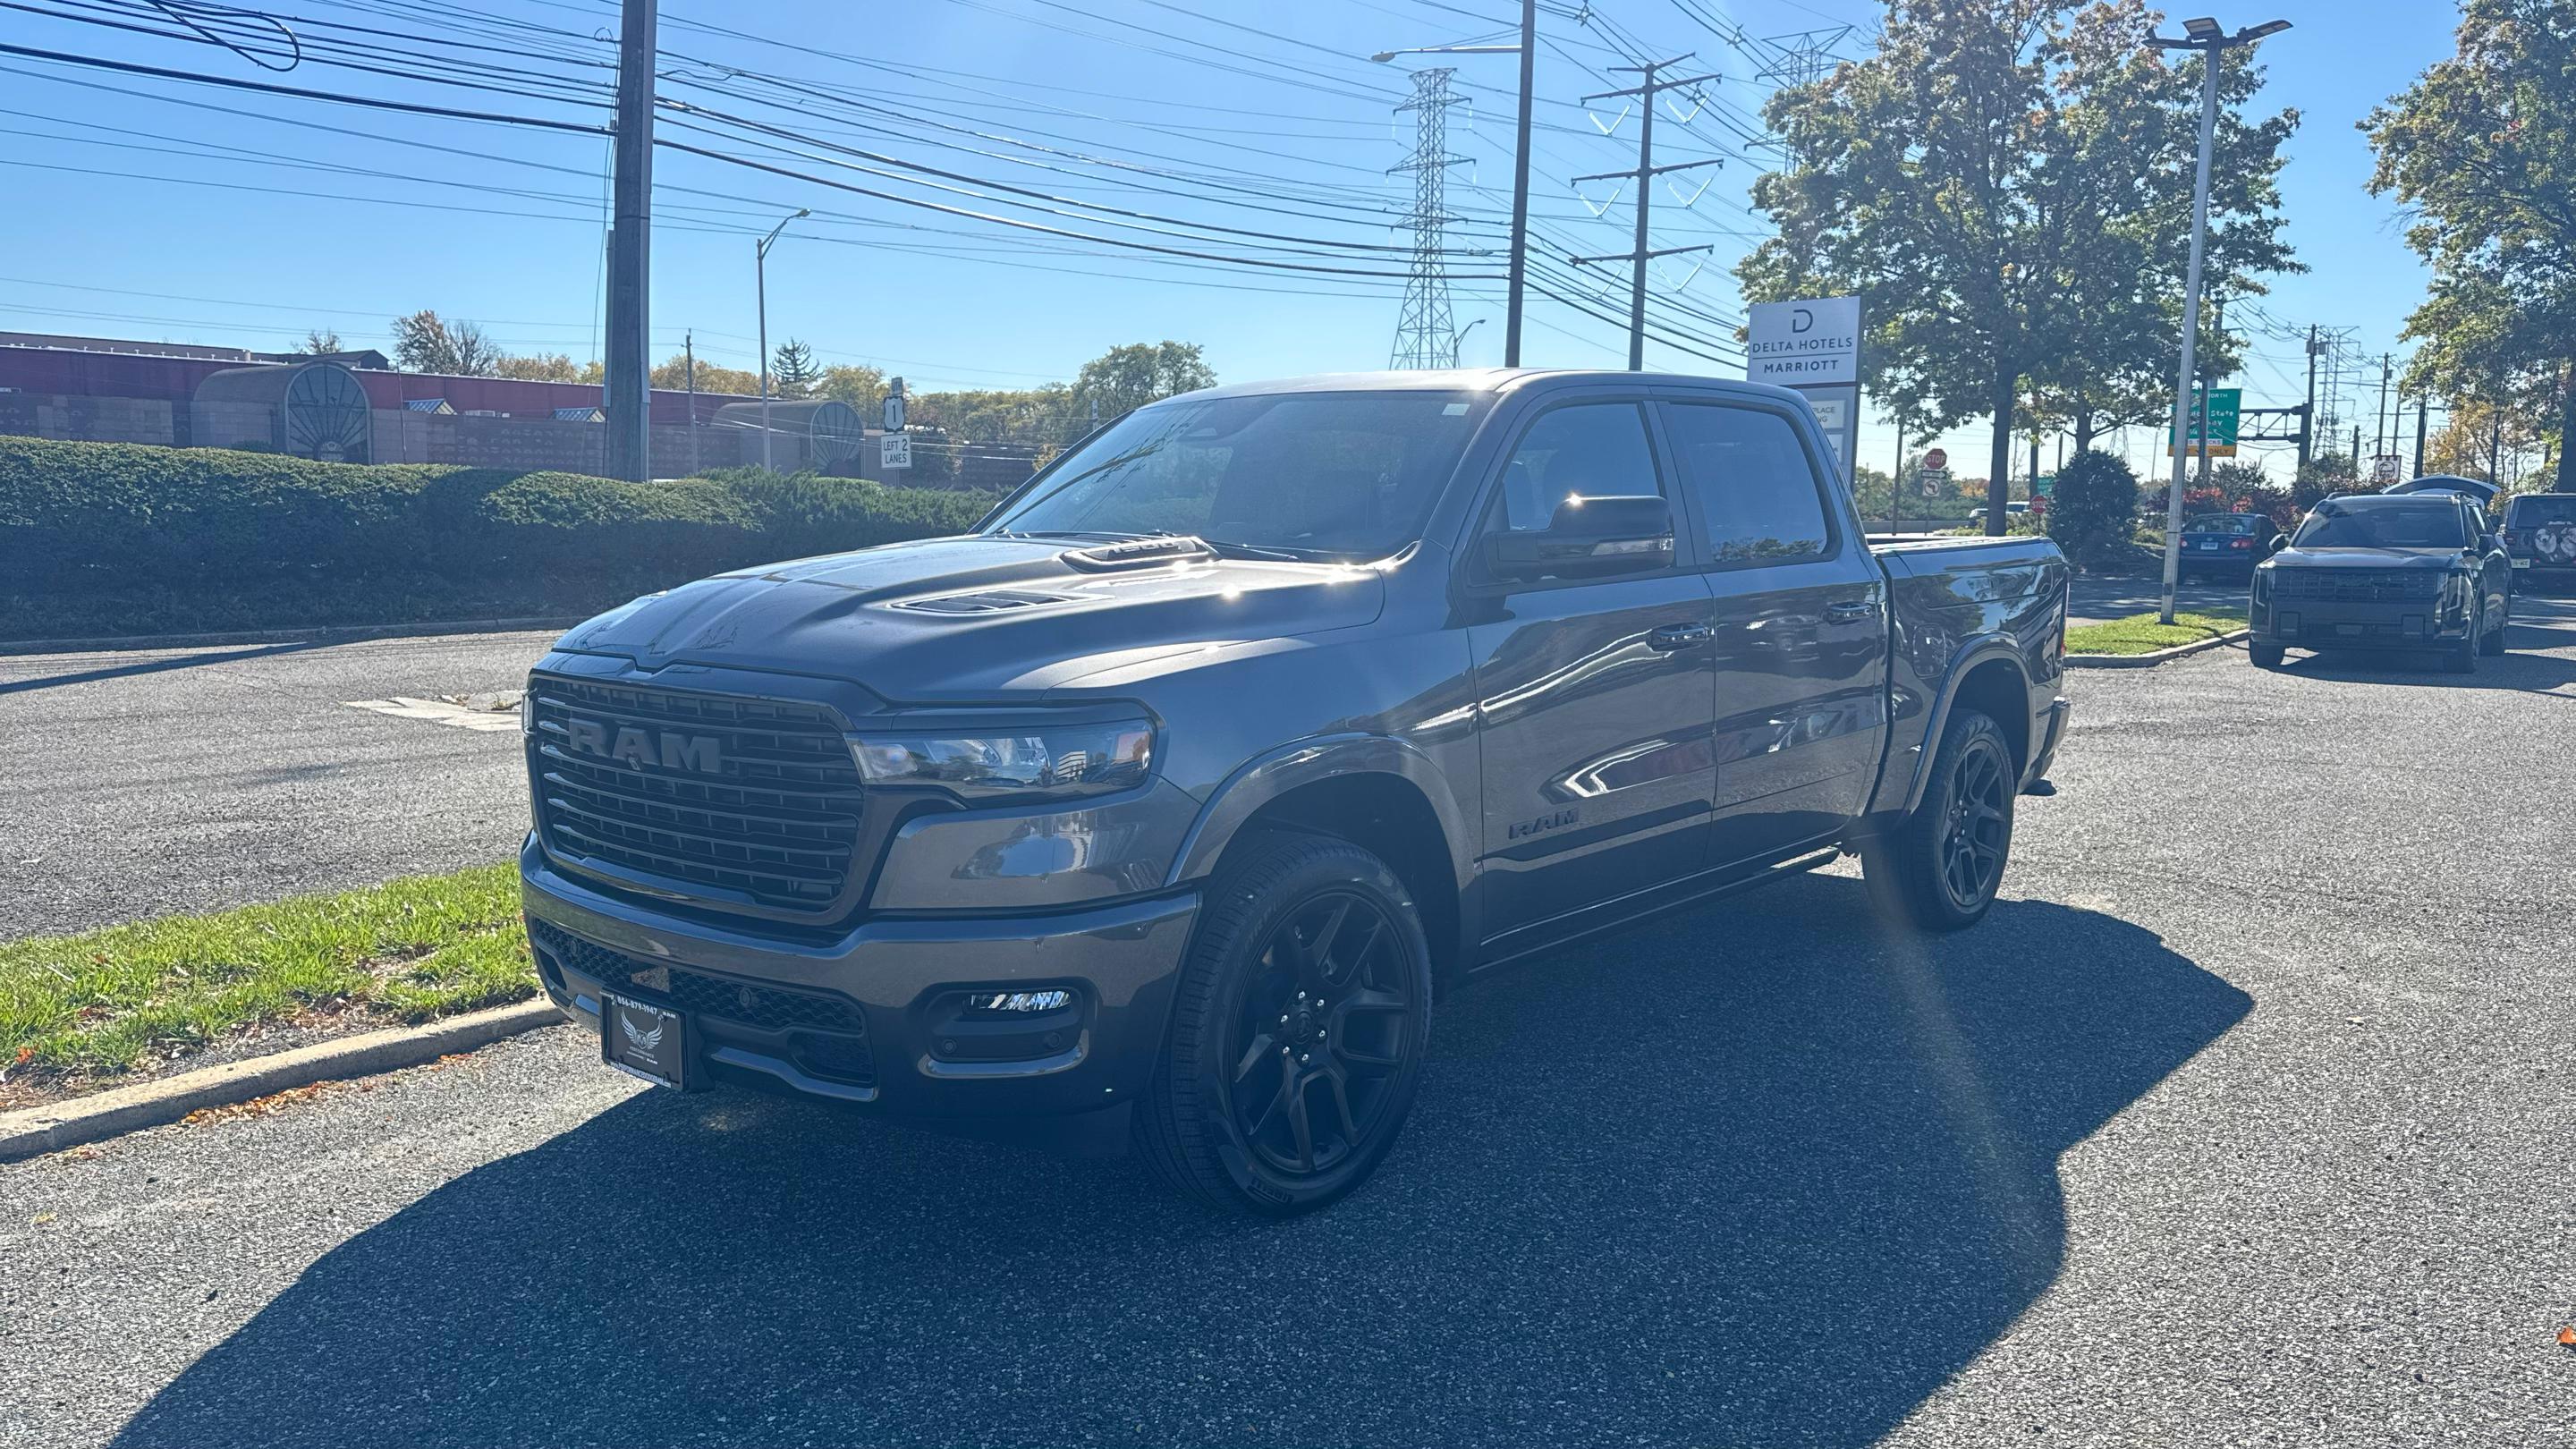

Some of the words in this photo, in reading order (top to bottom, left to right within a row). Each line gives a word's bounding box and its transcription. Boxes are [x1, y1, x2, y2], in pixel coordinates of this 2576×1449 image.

[1752, 341, 1793, 353] DELTA
[1799, 336, 1853, 351] HOTELS
[1763, 360, 1839, 374] MARRIOTT
[892, 403, 896, 423] 1
[883, 440, 898, 452] LEFT
[902, 438, 908, 452] 2
[2208, 447, 2229, 455] ONLY
[886, 453, 907, 464] LANES
[1927, 454, 1946, 464] STOP
[568, 717, 723, 774] RAM
[1508, 807, 1580, 840] RAM
